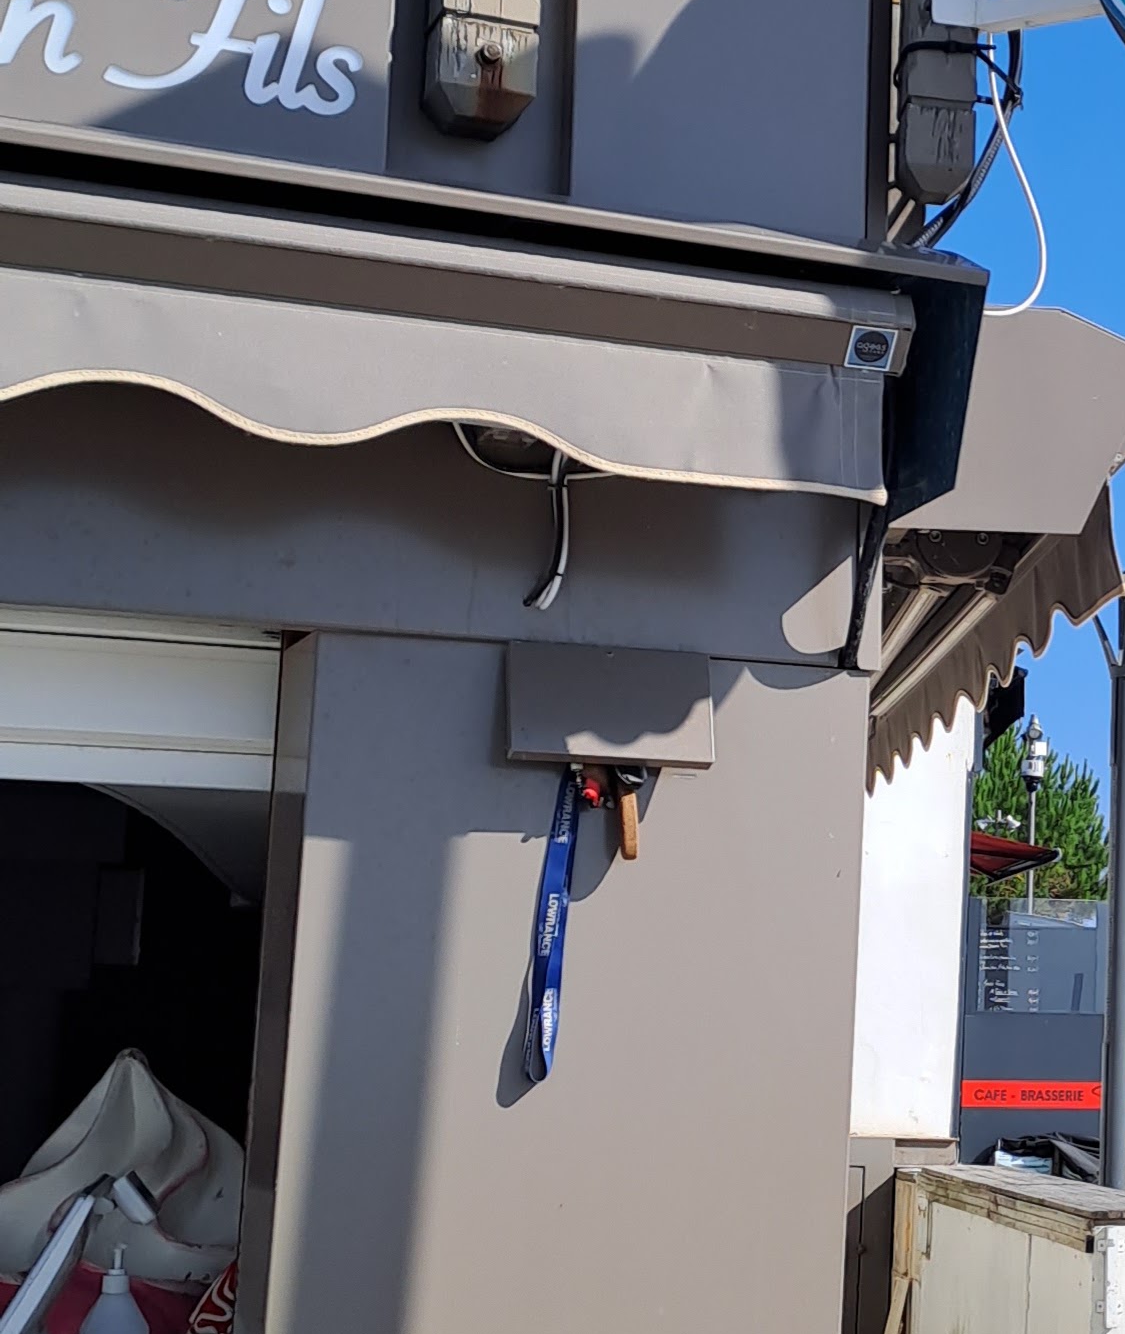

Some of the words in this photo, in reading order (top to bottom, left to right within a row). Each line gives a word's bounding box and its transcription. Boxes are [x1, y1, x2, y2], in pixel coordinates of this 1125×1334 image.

[558, 781, 577, 844] LOWRANCE
[540, 893, 560, 957] LOWRANCE
[542, 987, 554, 1052] LOWRANCE
[1020, 1089, 1084, 1102] BRASSERIE
